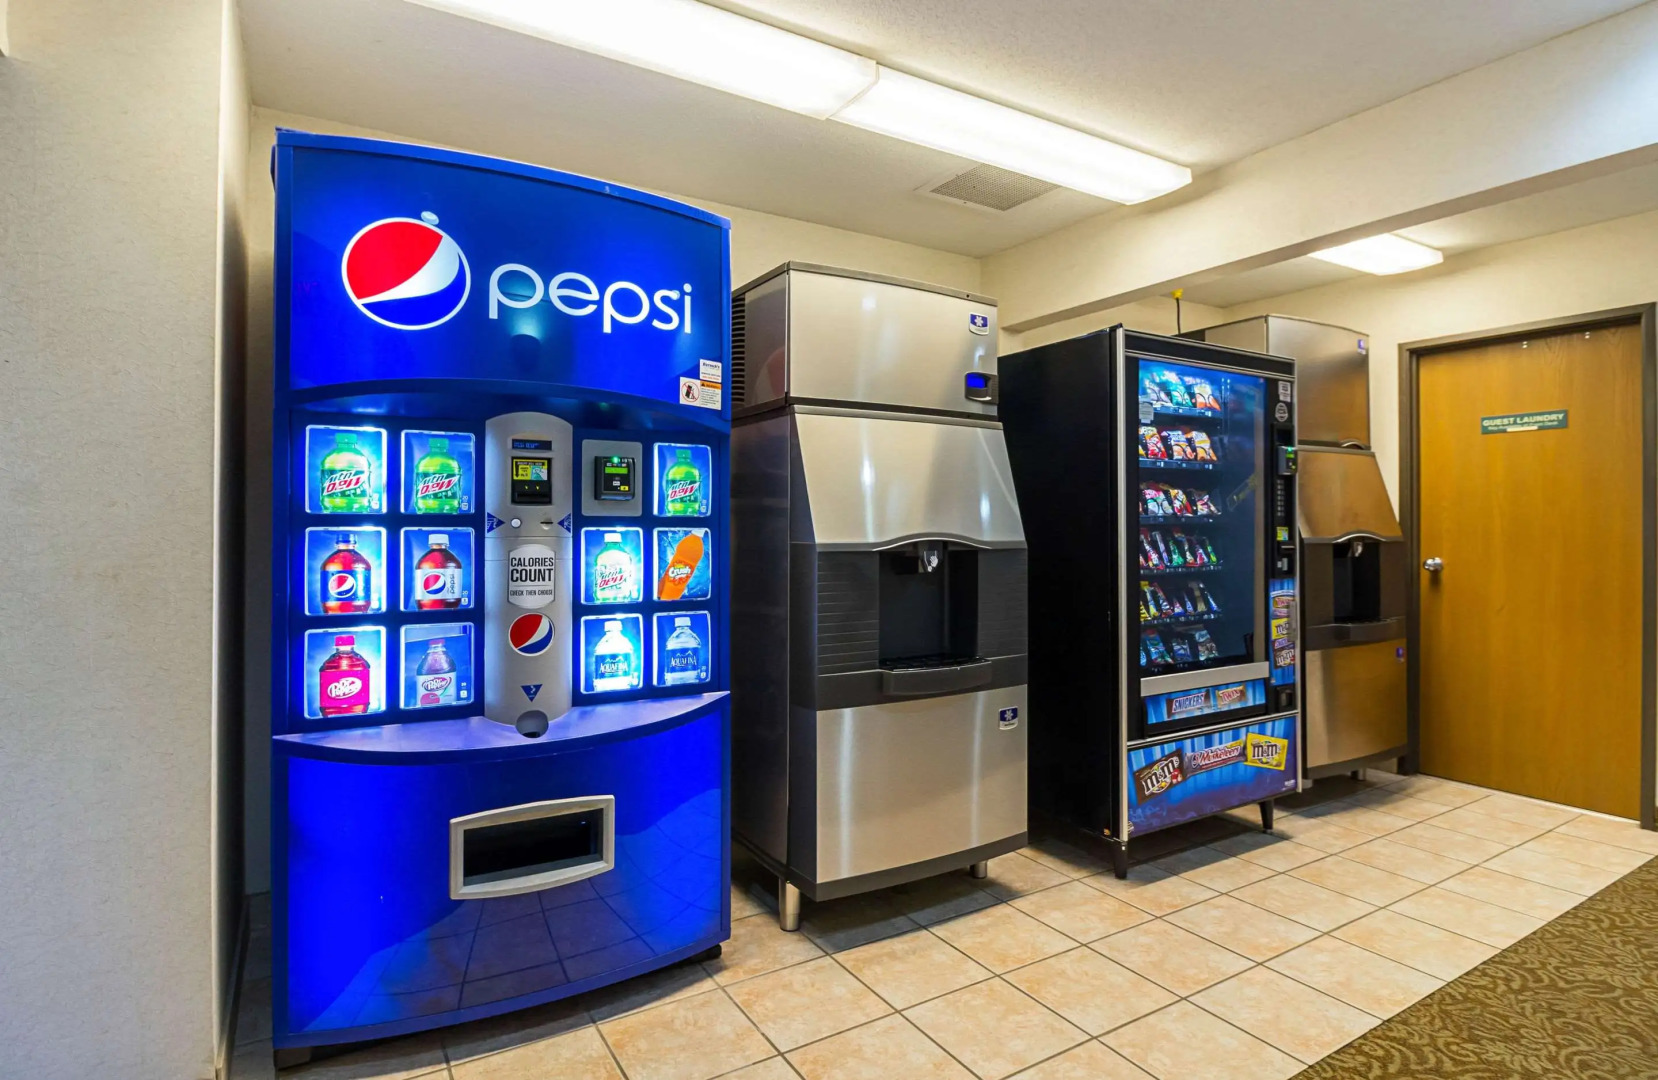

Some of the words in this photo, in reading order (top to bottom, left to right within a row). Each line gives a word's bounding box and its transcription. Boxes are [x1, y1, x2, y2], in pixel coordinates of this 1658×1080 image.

[488, 263, 692, 334] pepsi
[1482, 418, 1515, 427] GUEST
[1516, 413, 1565, 424] LAUNDRY
[510, 557, 554, 568] CALORIES
[510, 568, 554, 583] COUNT
[668, 566, 692, 579] Crush
[599, 662, 628, 674] AQUAFINA
[670, 656, 697, 668] AQUAFINA
[1173, 693, 1205, 712] SNICKERS
[1199, 745, 1241, 765] Musketeers
